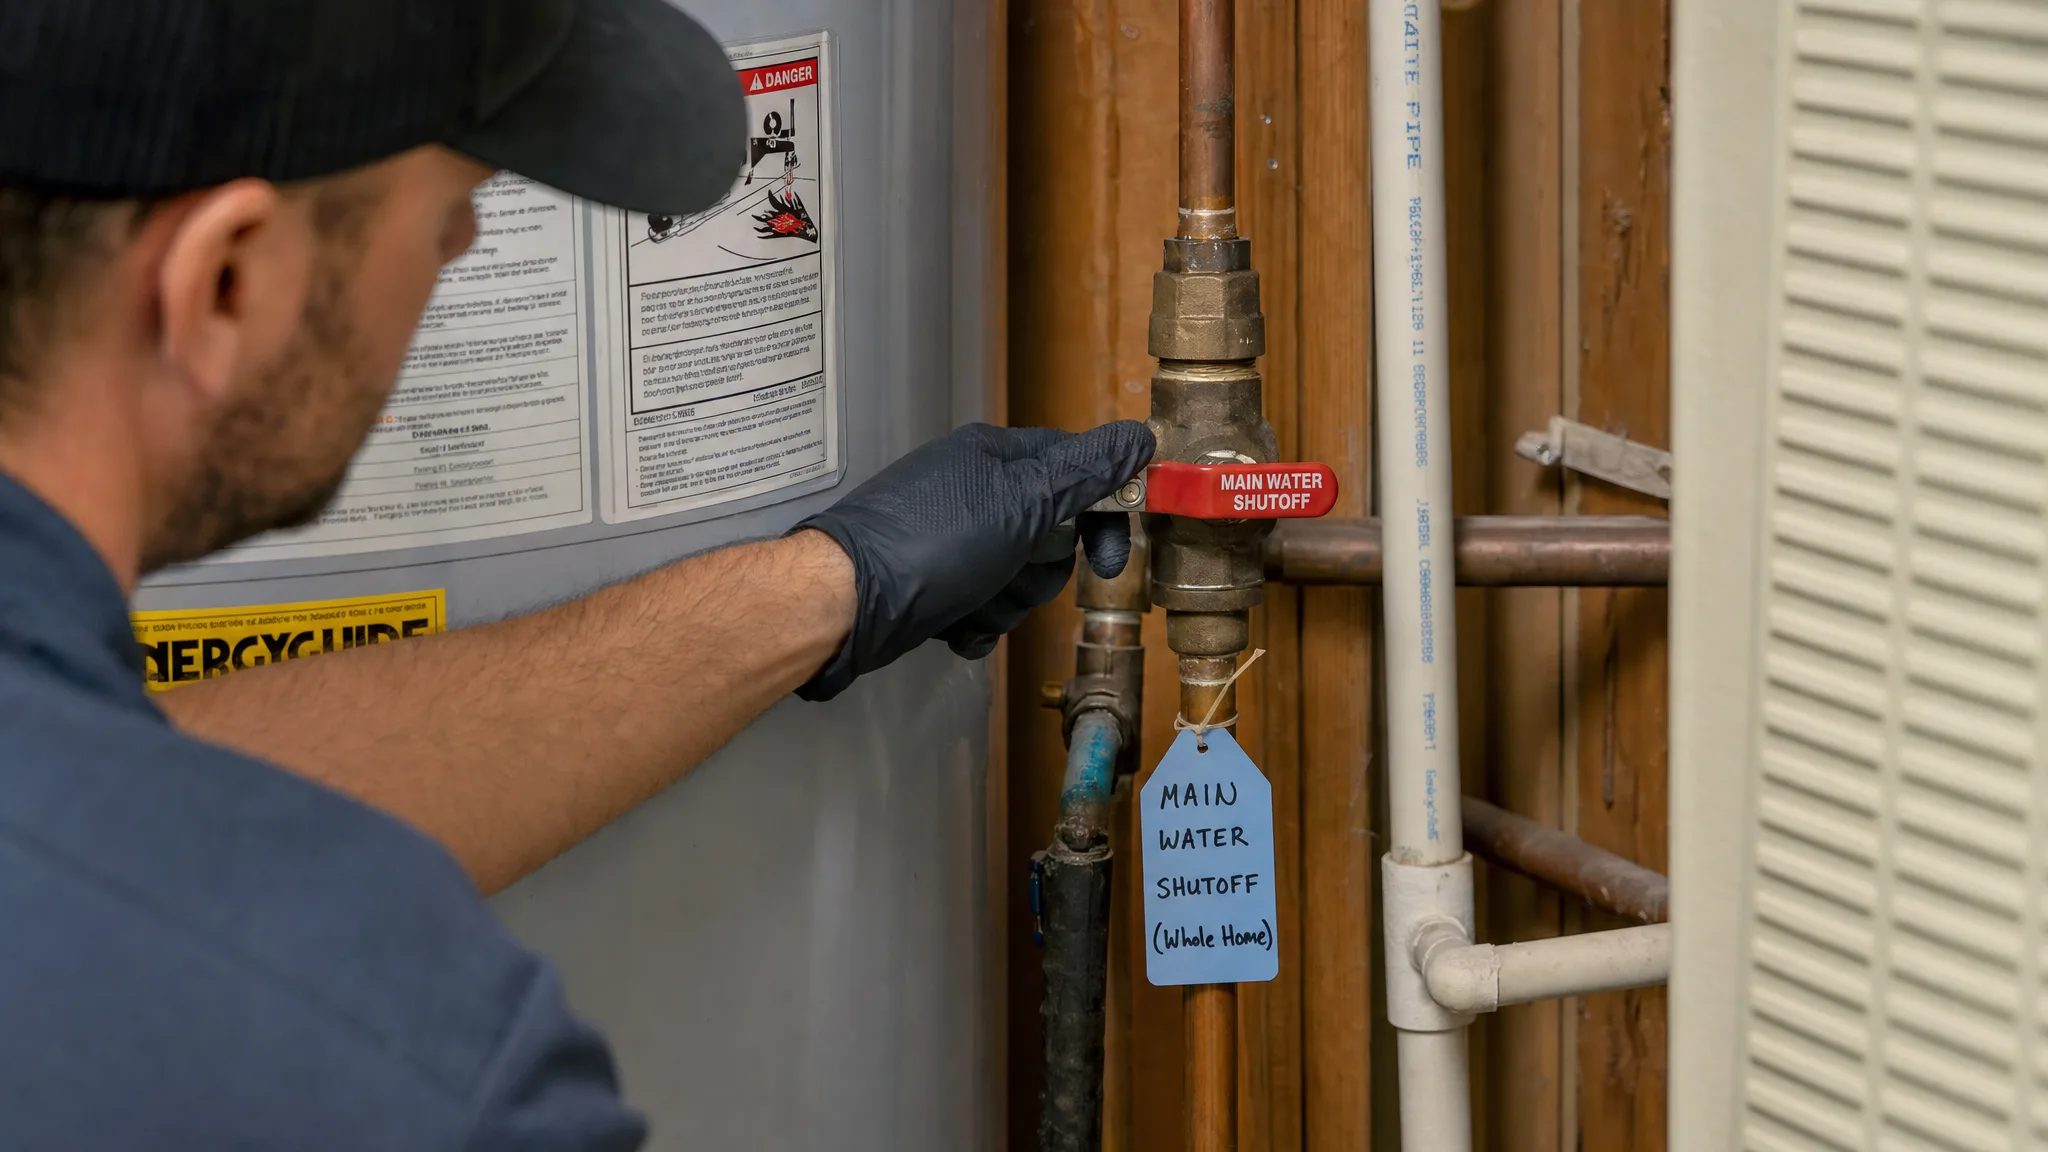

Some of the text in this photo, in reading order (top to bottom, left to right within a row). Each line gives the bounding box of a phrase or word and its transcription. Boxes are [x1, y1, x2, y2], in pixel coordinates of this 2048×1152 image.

[765, 65, 813, 88] DANGER
[1406, 102, 1422, 169] PIPE
[1221, 473, 1323, 490] MAIN WATER
[1233, 493, 1310, 511] SHUTOFF
[1160, 781, 1237, 810] MAIN
[1159, 826, 1249, 850] WATER
[1156, 873, 1258, 899] SHUTOFF
[1153, 918, 1273, 955] (Whole Home)
